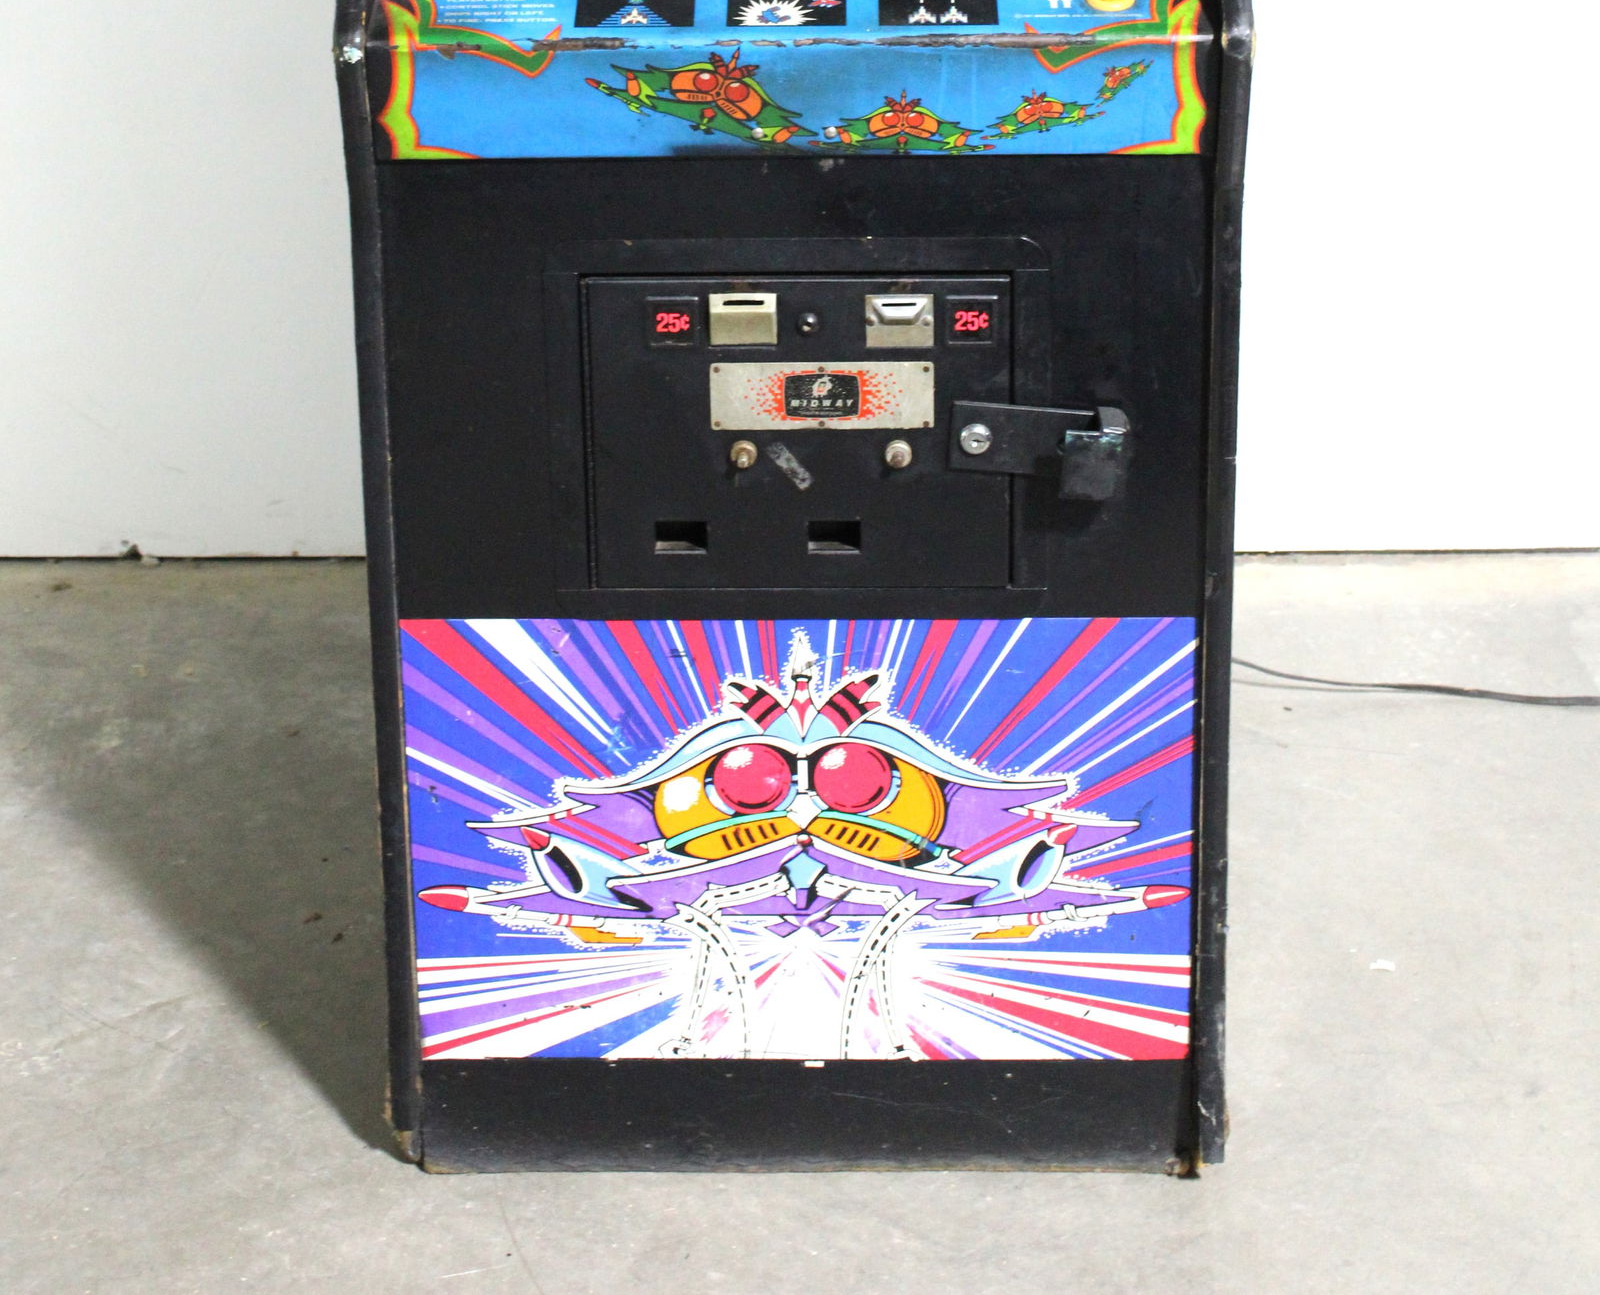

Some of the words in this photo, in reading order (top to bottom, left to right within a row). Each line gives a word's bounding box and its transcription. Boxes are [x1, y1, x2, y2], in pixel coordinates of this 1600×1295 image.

[656, 312, 690, 333] 25¢
[954, 310, 990, 332] 25¢
[789, 399, 854, 408] MIDWAY
